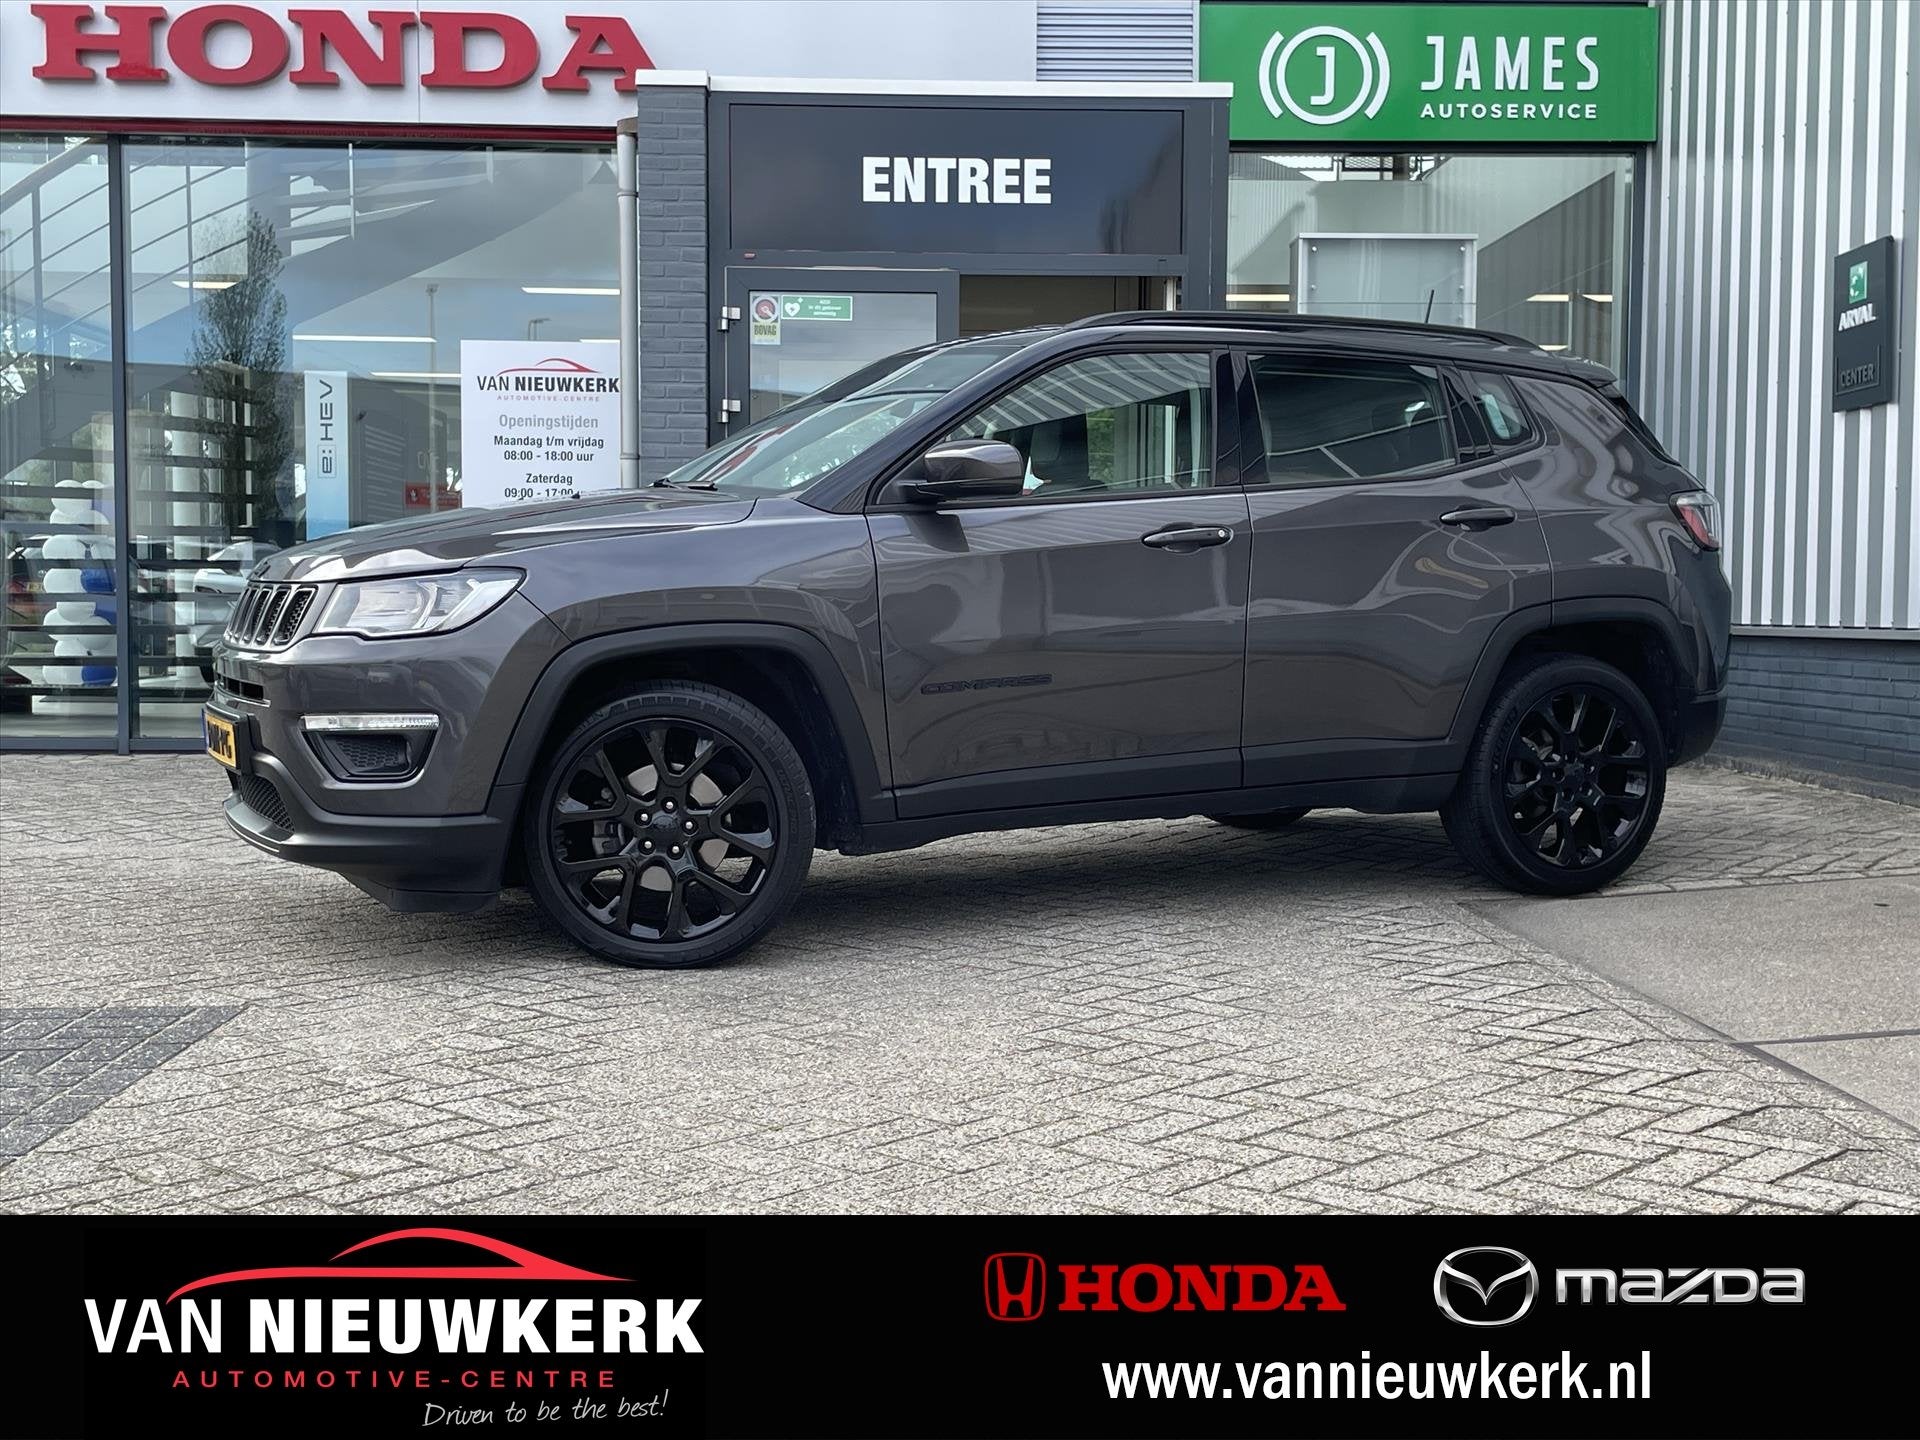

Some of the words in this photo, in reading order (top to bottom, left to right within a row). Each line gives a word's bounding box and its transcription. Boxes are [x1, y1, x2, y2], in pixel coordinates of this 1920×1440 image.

[31, 4, 656, 91] HONDA
[1420, 35, 1599, 91] JAMES
[1420, 103, 1597, 119] AUTOSERVICE
[862, 156, 1052, 204] ENTREE
[1838, 303, 1877, 331] ARVAL
[1840, 363, 1875, 387] CENTER
[477, 375, 510, 391] VAN
[515, 376, 620, 393] NIEUWKERK
[499, 414, 599, 430] Openingstijden
[494, 435, 543, 448] Maandag
[546, 436, 565, 446] t/m
[568, 437, 604, 449] vrijdag
[504, 450, 533, 461] 08:00
[545, 451, 574, 462] 18:00
[577, 453, 594, 462] uur
[526, 473, 573, 485] Zaterdag
[504, 488, 534, 499] 09:00
